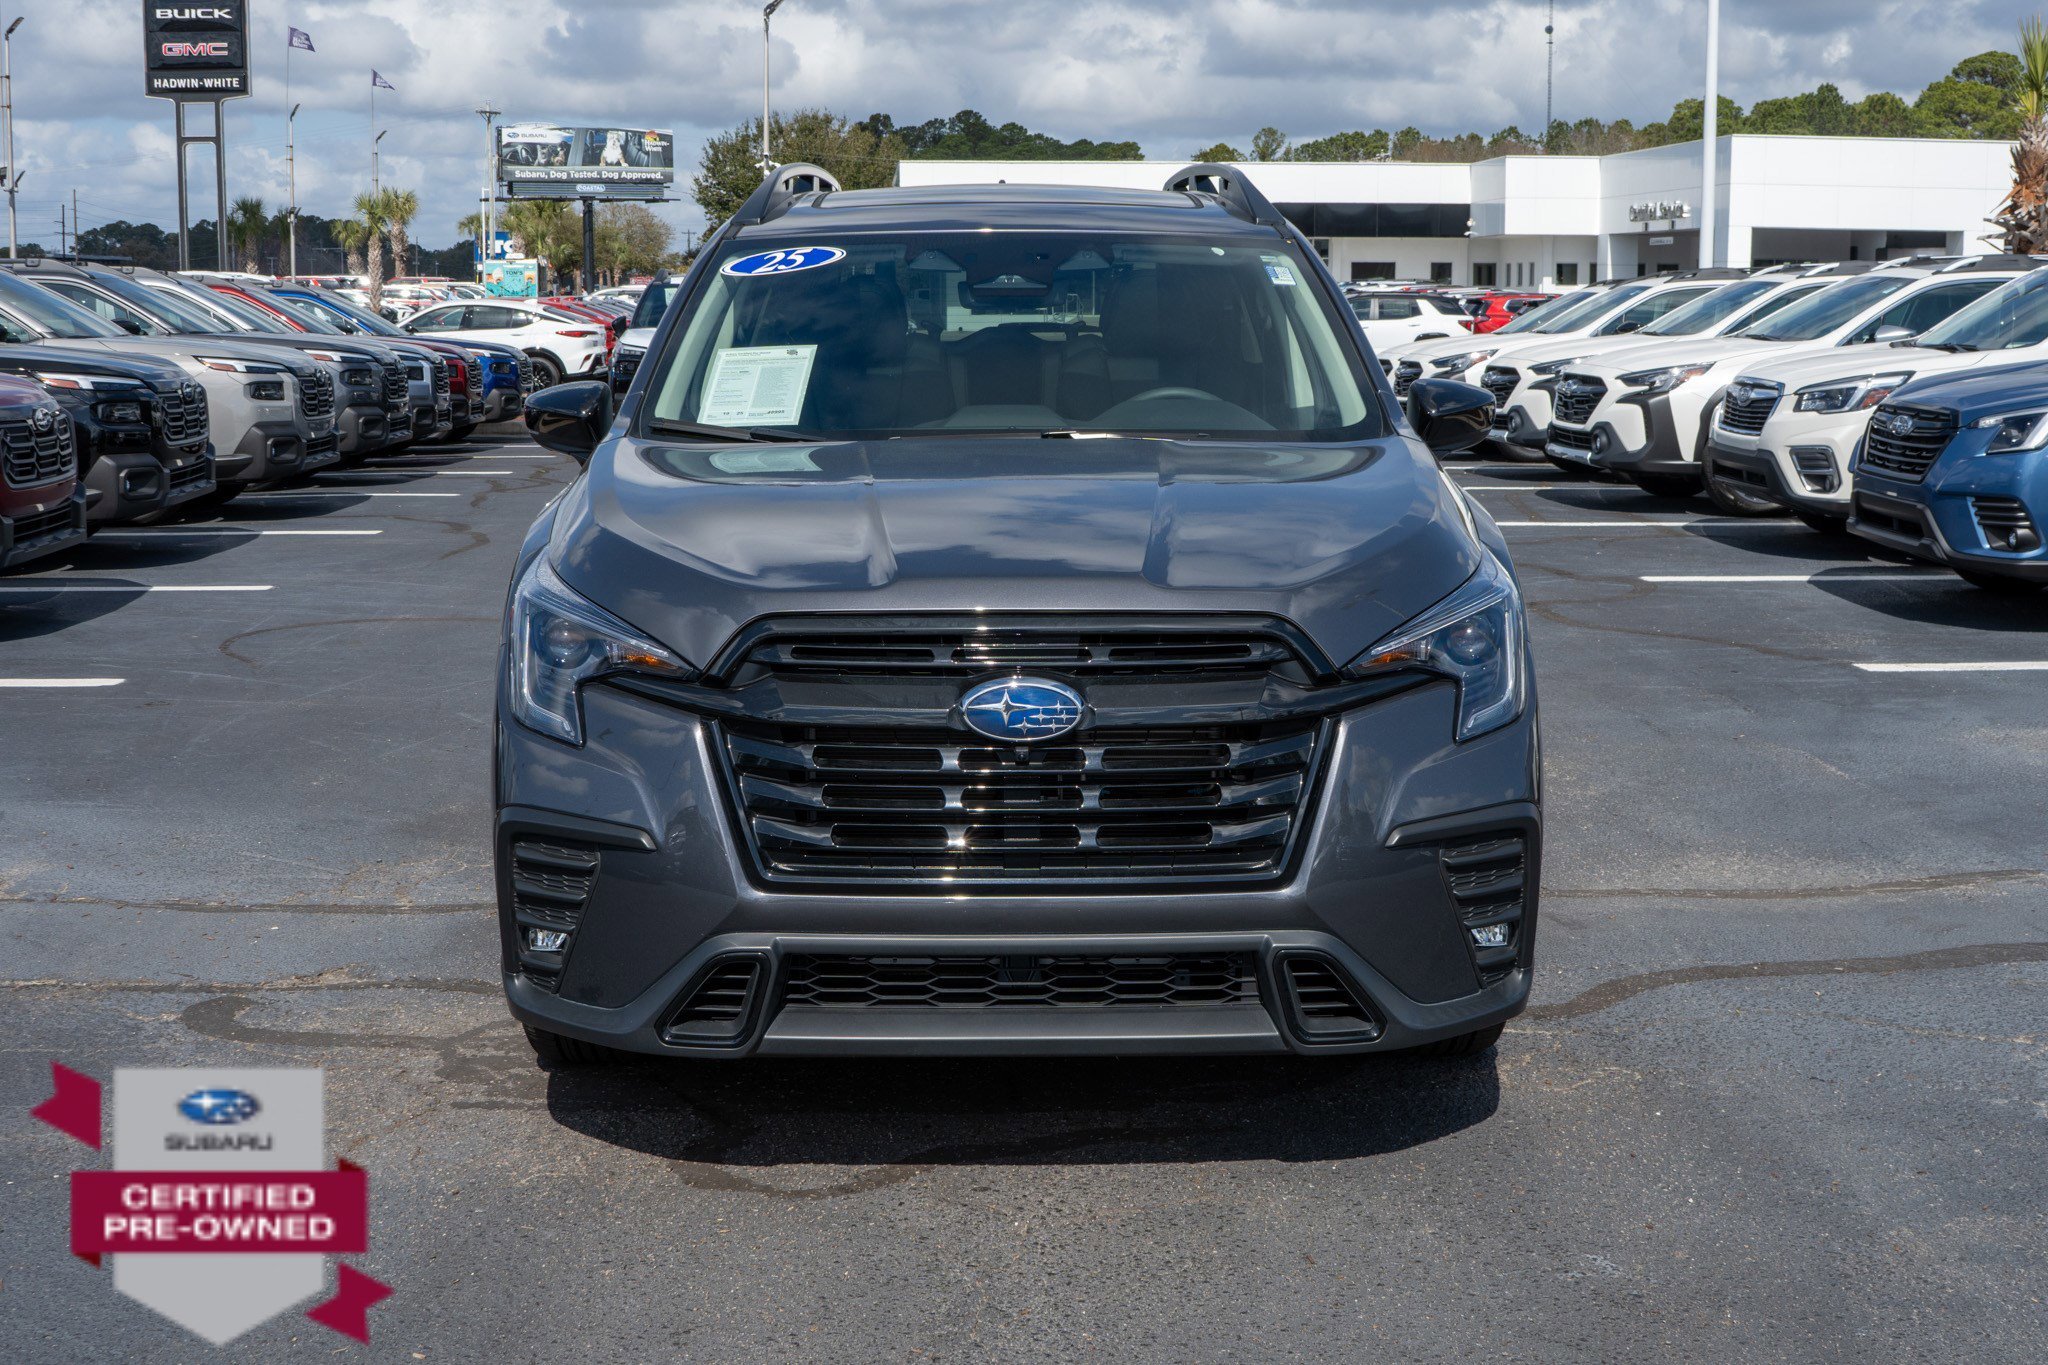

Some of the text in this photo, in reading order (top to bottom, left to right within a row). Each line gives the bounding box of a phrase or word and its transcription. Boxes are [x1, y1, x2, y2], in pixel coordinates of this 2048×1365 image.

[155, 8, 233, 19] BUICK
[162, 42, 229, 56] GMC
[153, 77, 240, 89] HADWIN-WHITE
[515, 170, 664, 180] Subaru, Dog Tested. Dog Approved.
[751, 248, 815, 274] 25
